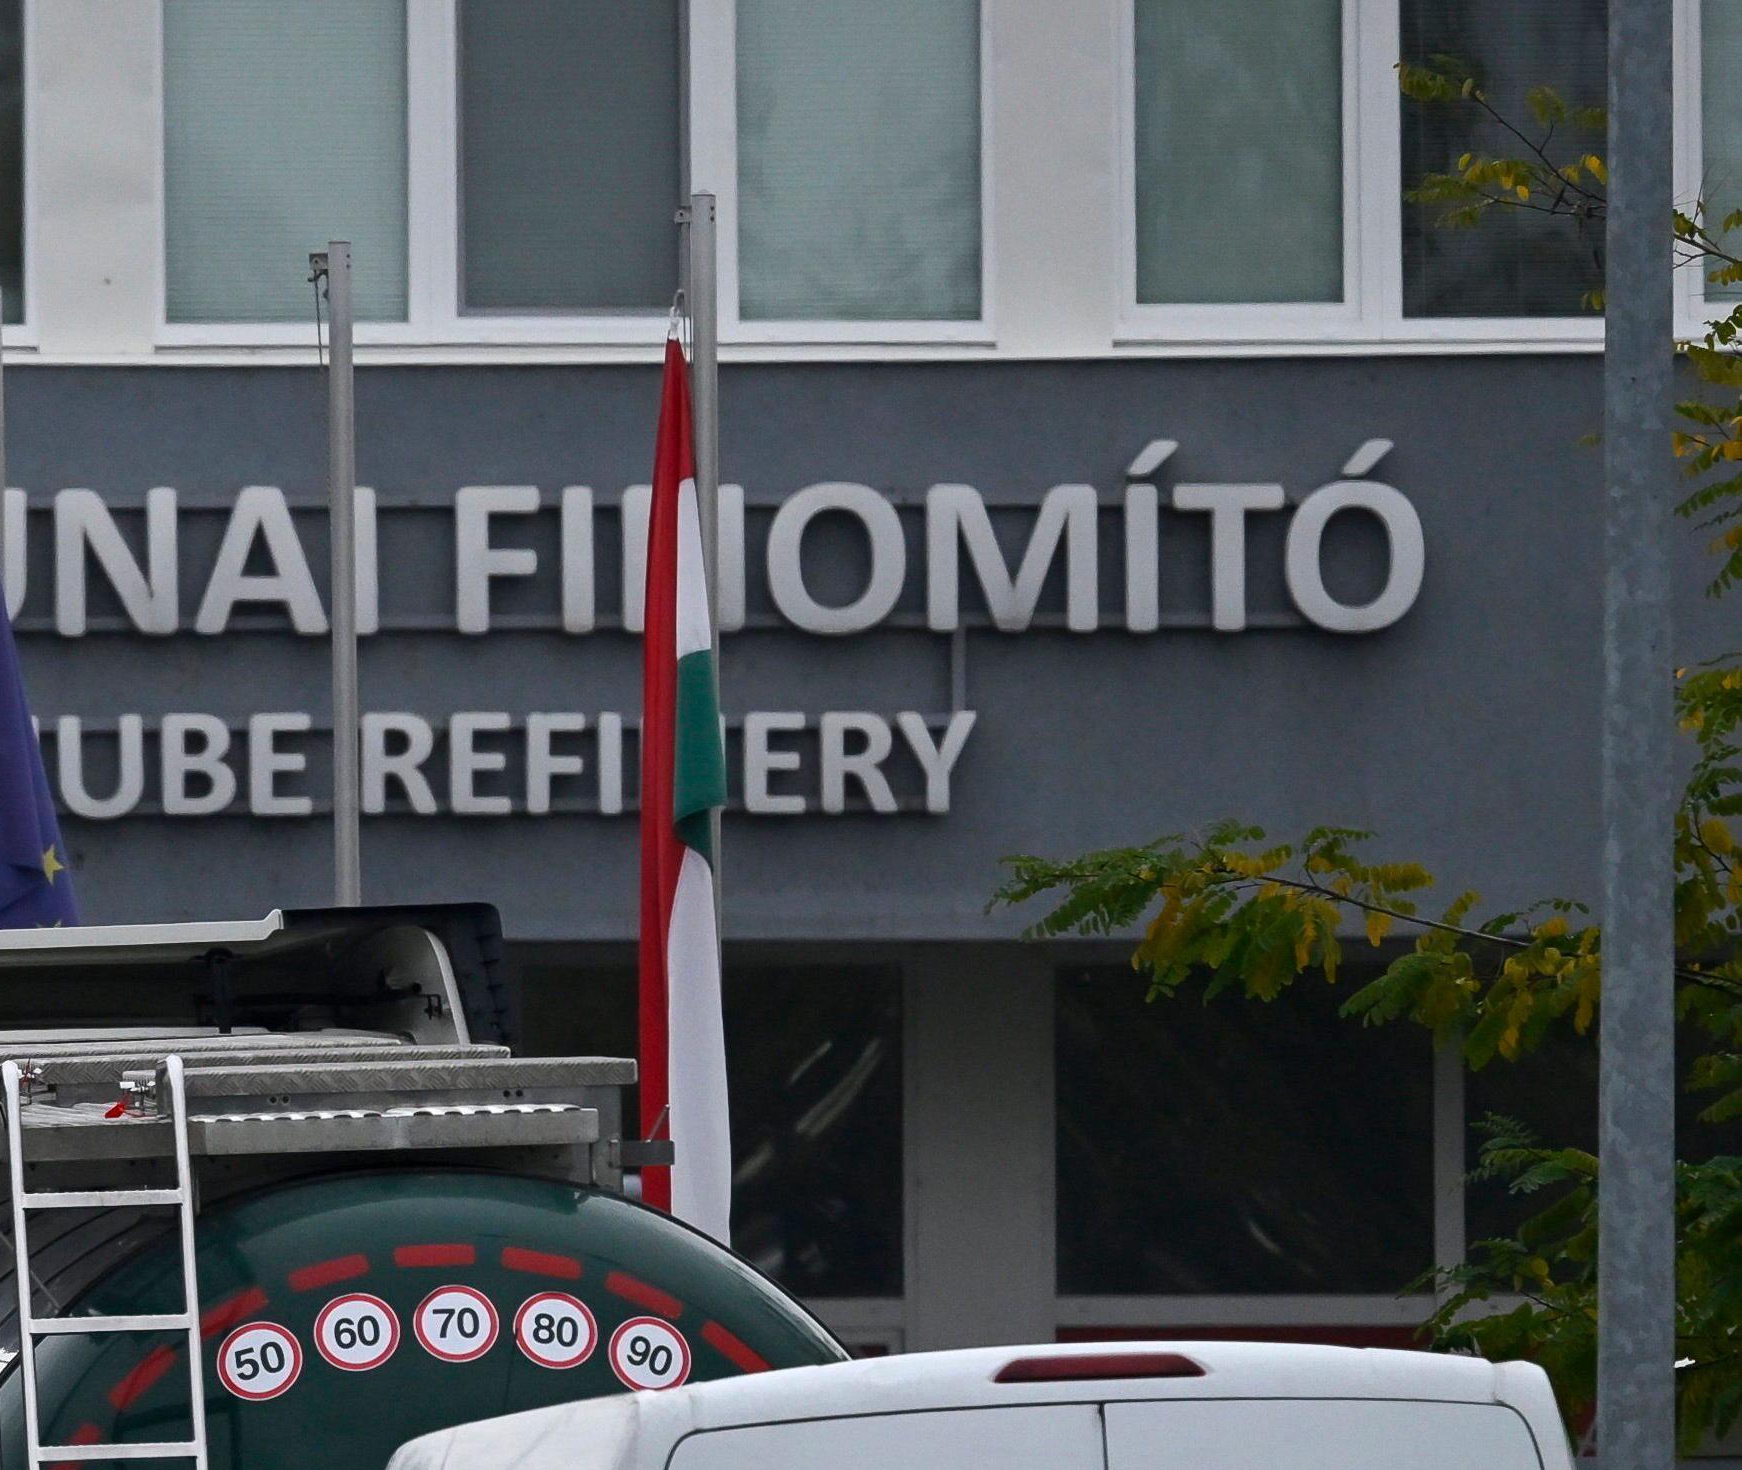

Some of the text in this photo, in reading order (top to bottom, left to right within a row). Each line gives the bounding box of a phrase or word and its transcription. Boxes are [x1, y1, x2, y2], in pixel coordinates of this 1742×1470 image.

[361, 710, 977, 815] REFIERY
[333, 1315, 381, 1350] 60
[432, 1307, 480, 1339] 70
[532, 1313, 579, 1348] 80
[234, 1341, 286, 1381] 50
[626, 1335, 673, 1376] 90
